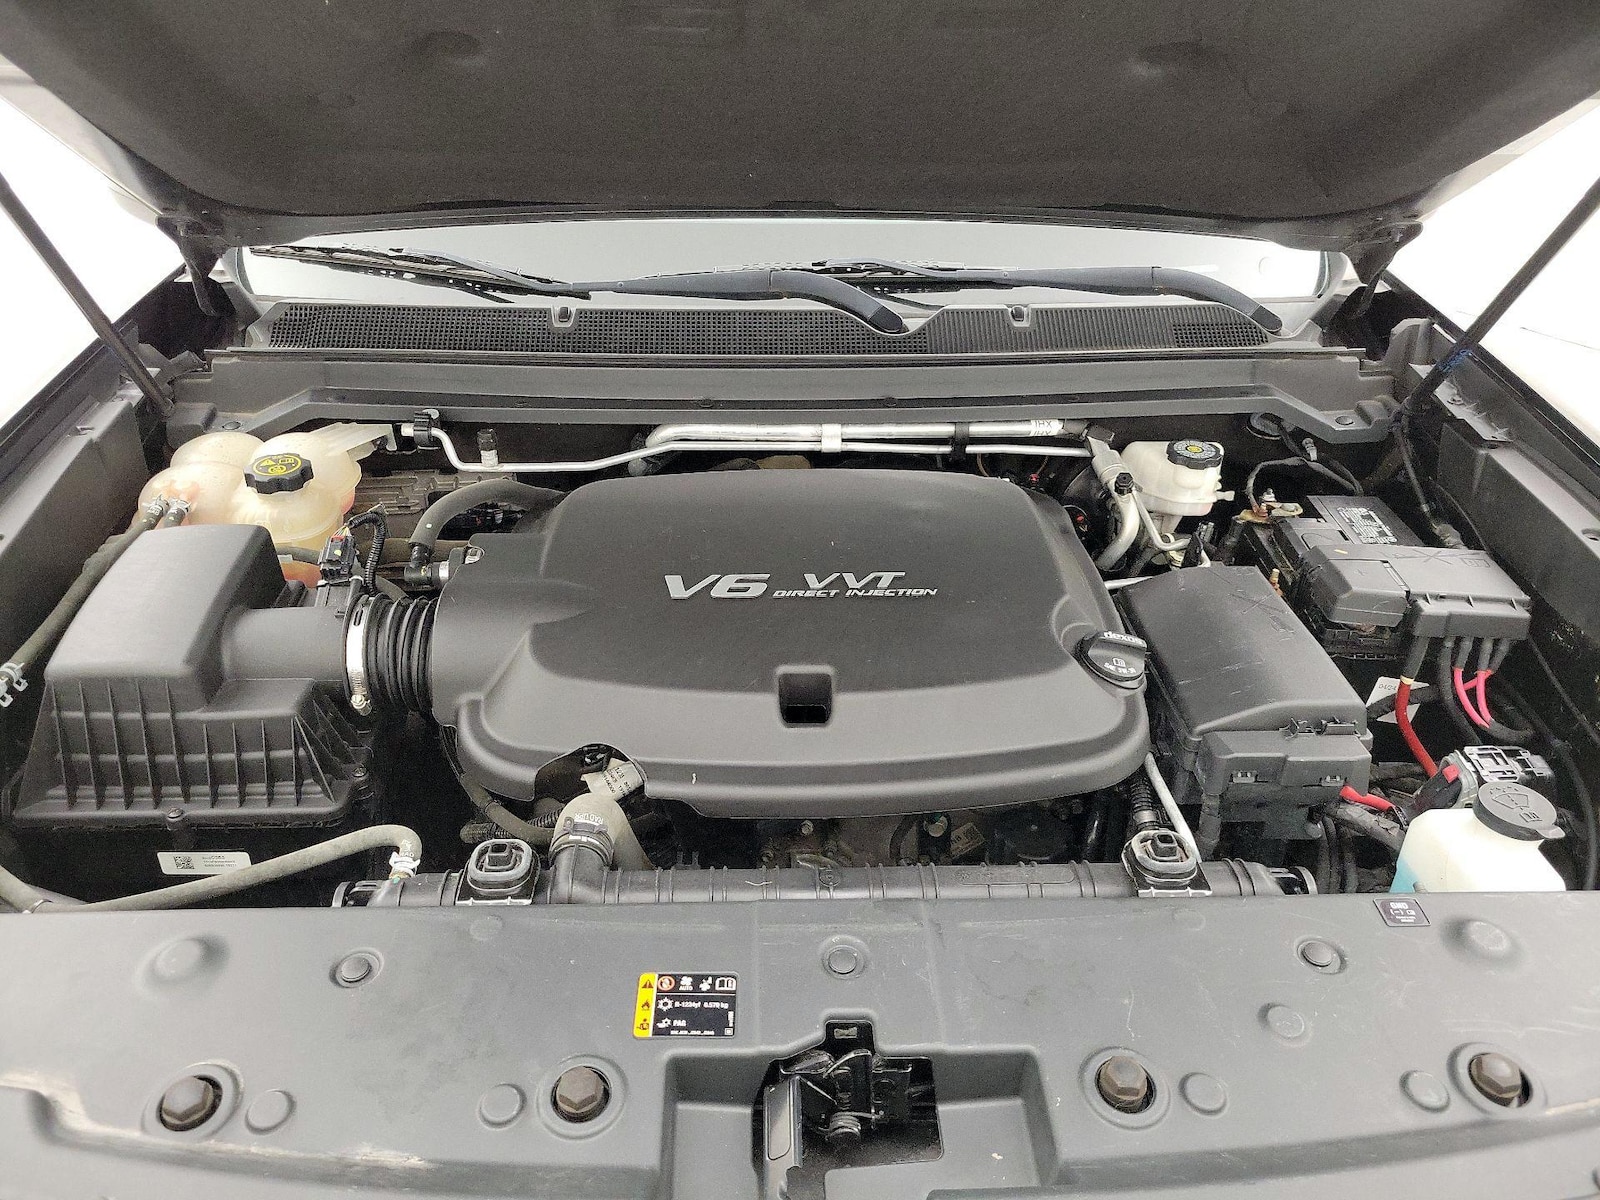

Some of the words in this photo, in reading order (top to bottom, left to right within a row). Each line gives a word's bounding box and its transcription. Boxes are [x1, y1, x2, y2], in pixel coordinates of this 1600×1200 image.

[664, 573, 771, 600] V6
[803, 571, 906, 589] VVT
[772, 589, 840, 598] DIRECT
[845, 588, 938, 597] INJECTION
